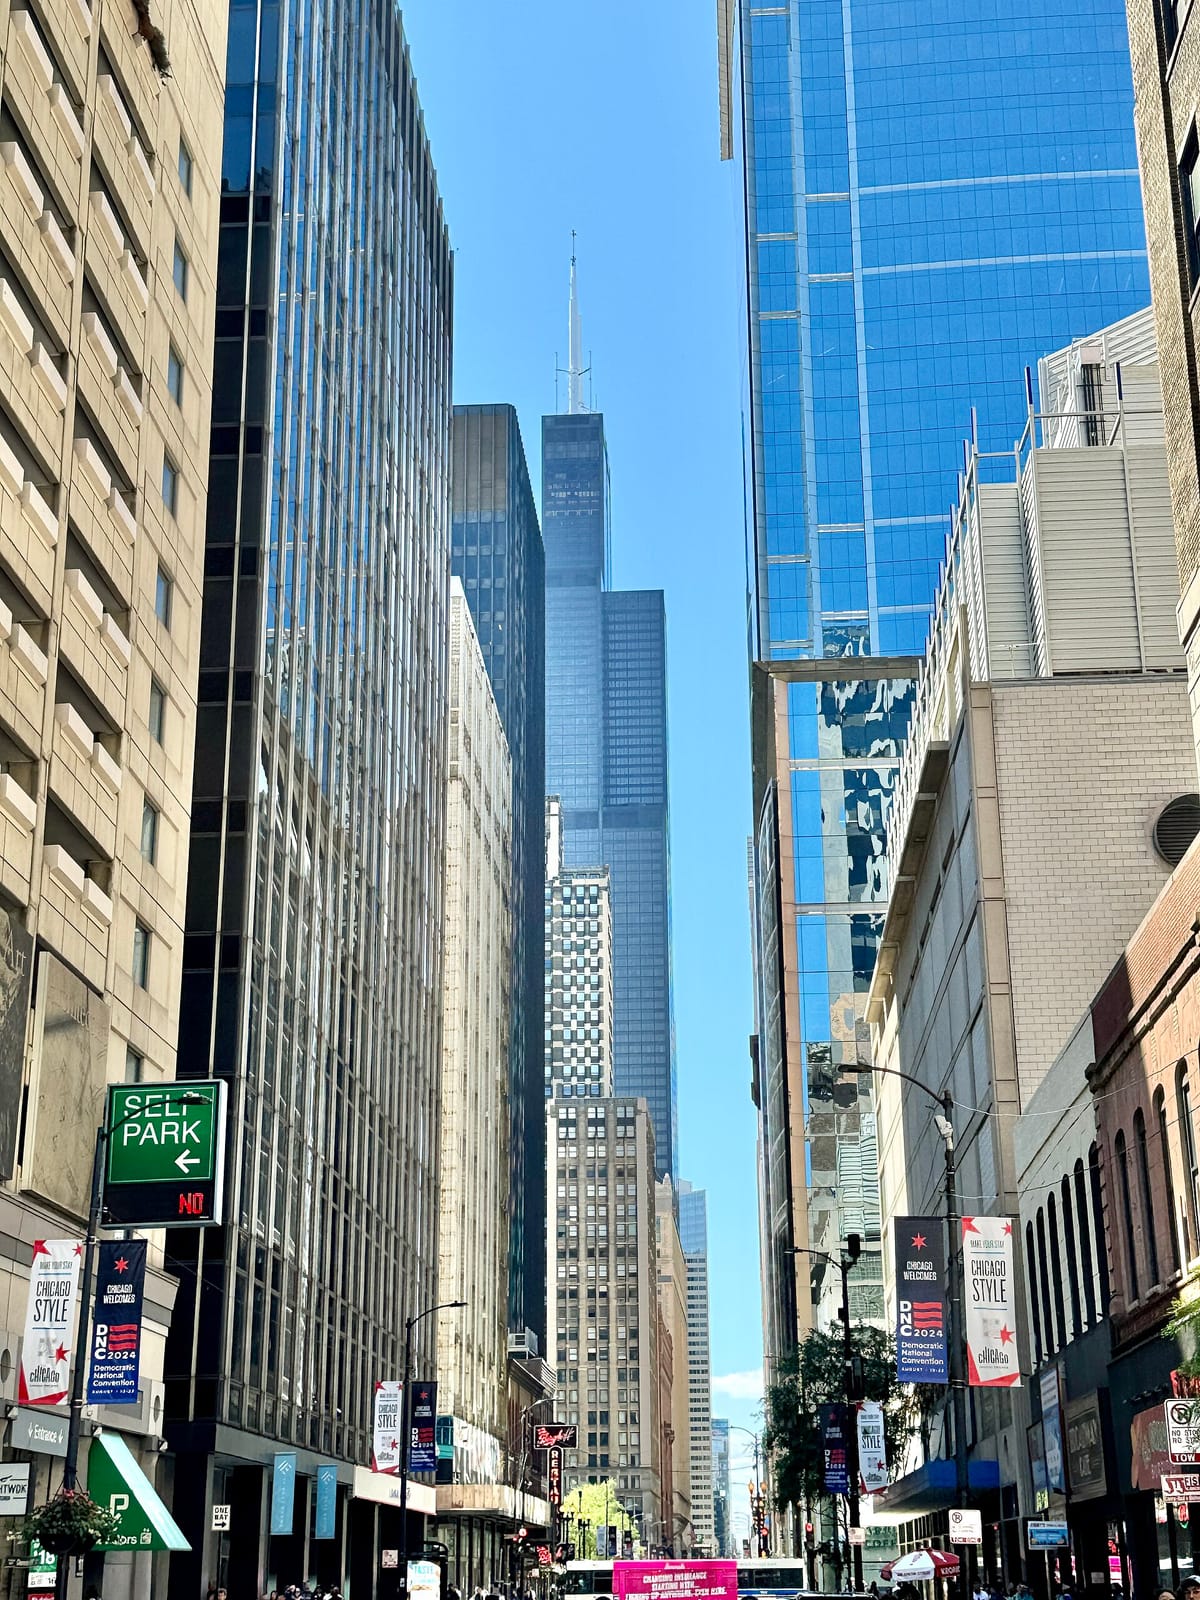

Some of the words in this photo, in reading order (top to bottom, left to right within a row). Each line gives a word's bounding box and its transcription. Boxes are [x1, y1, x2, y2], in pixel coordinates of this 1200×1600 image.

[123, 1120, 201, 1146] PARK
[178, 1193, 204, 1214] NO
[970, 1240, 982, 1248] MAKE
[983, 1240, 994, 1249] YOUR
[994, 1240, 1005, 1248] STAY
[907, 1261, 933, 1270] CHICAGO
[970, 1260, 1006, 1277] CHICAGO
[903, 1272, 937, 1281] WELCOMES
[36, 1280, 71, 1297] CHICAGO
[107, 1284, 133, 1293] CHICAGO
[973, 1279, 1007, 1303] STYLE
[103, 1294, 136, 1304] WELCOMES
[33, 1299, 69, 1322] STYLE
[913, 1329, 943, 1337] 2024
[901, 1341, 944, 1350] Democratic
[107, 1351, 136, 1360] 2024
[901, 1349, 933, 1357] National
[901, 1357, 944, 1365] Convention
[92, 1379, 135, 1387] Convention
[377, 1414, 397, 1428] STYLE
[34, 1424, 57, 1443] Entrance
[861, 1435, 881, 1448] STYLE
[1174, 1454, 1196, 1462] TOW
[1184, 1476, 1199, 1487] FIS
[110, 1494, 129, 1518] P
